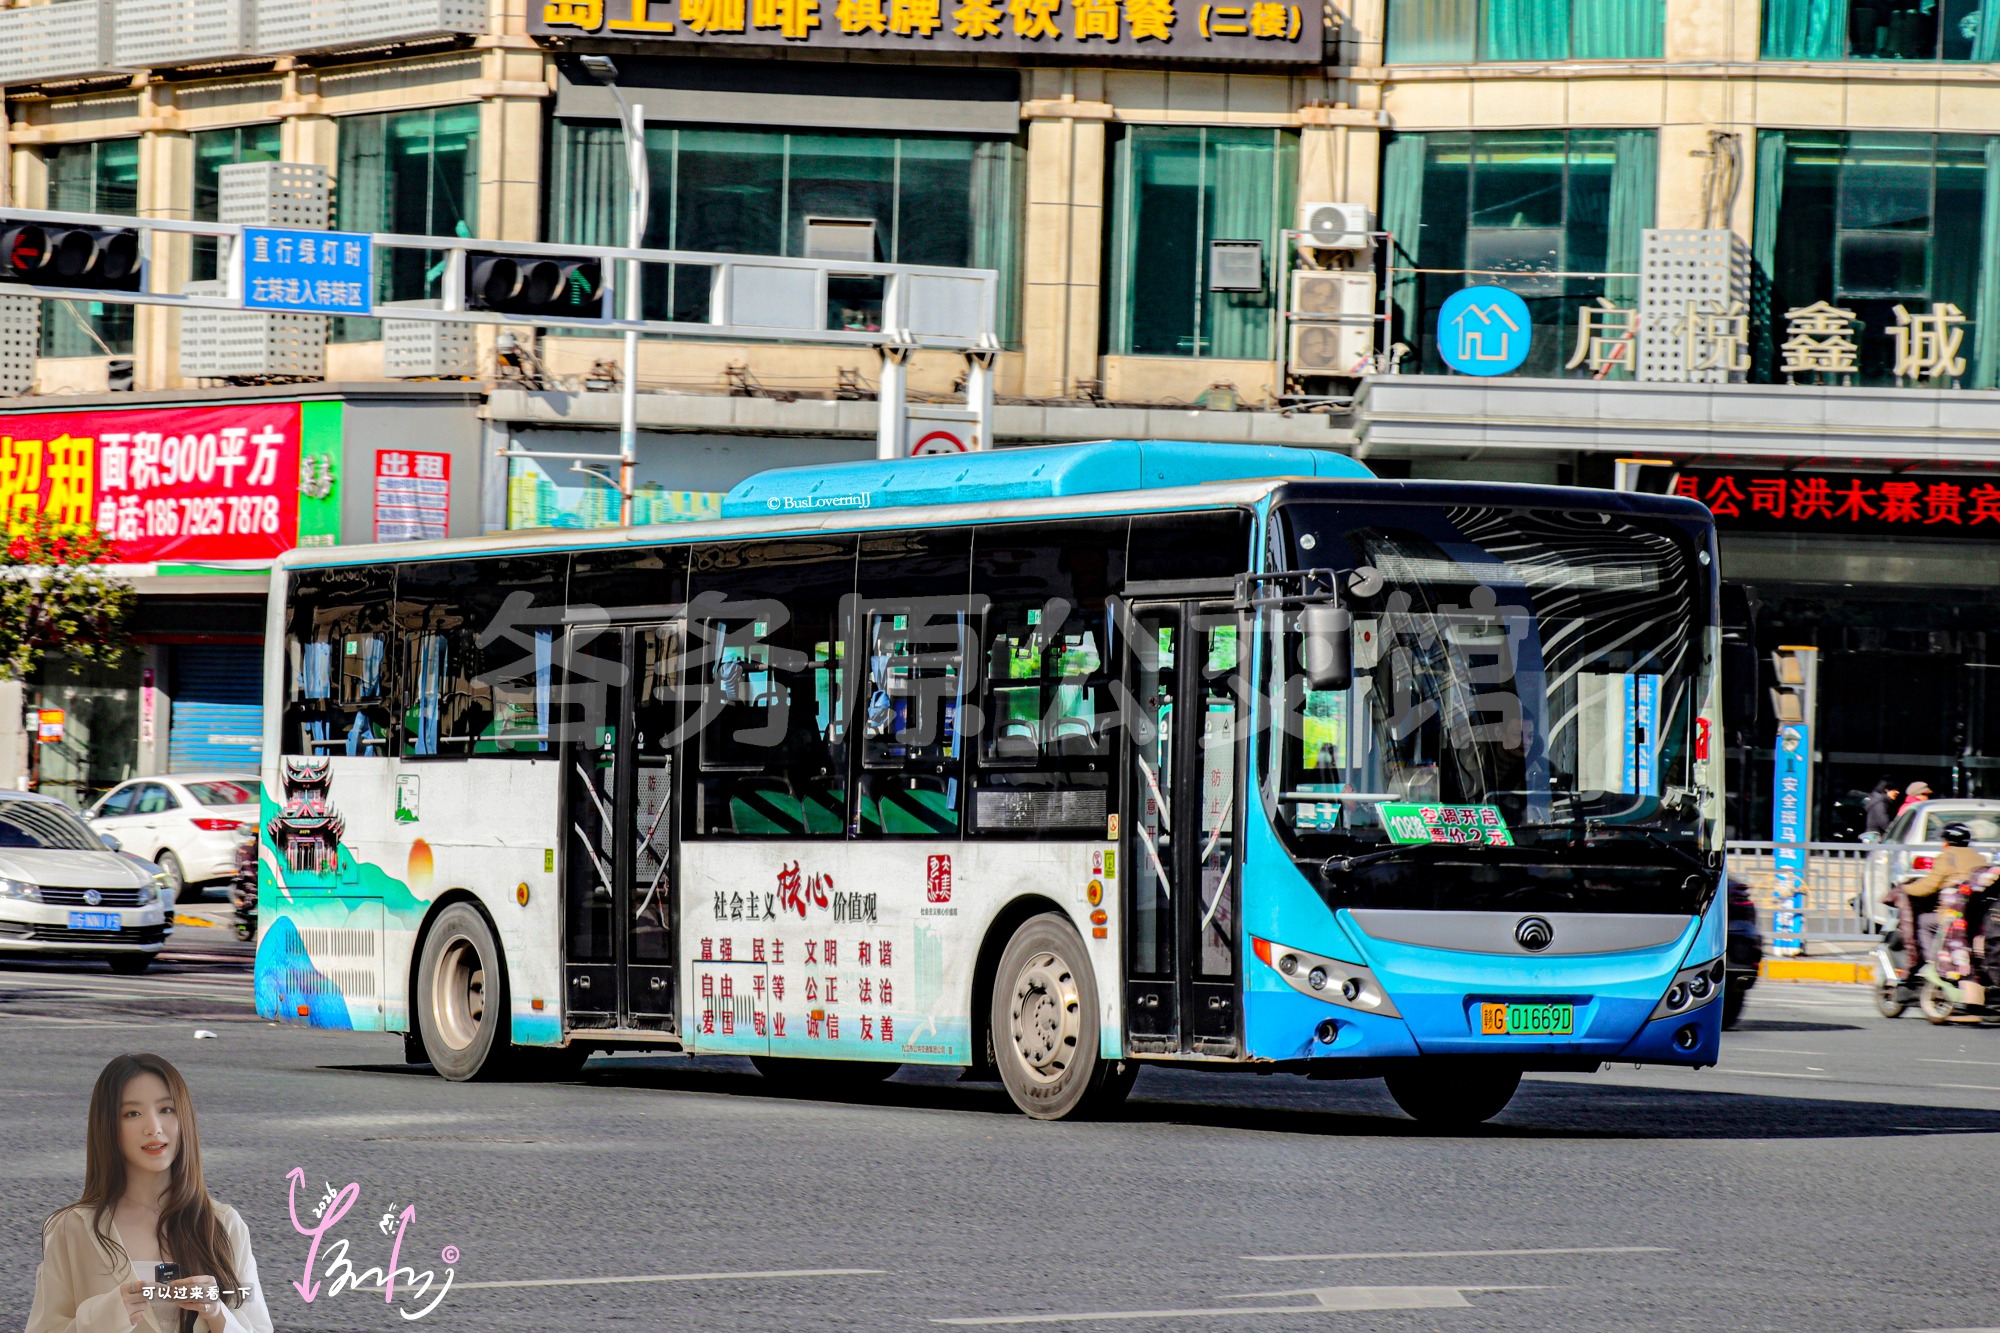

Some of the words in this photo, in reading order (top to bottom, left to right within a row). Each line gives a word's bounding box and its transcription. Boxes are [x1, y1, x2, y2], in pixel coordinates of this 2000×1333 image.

[252, 235, 362, 267] 直行绿灯时
[251, 276, 363, 306] 左转进入待转区
[1565, 296, 1968, 379] 启悦鑫诚
[99, 424, 285, 493] 面积900平方
[381, 452, 445, 478] 出租
[1419, 806, 1500, 826] 空调开启
[700, 936, 733, 962] 富强
[752, 937, 785, 965] 民主
[803, 938, 838, 967] 文明
[857, 939, 892, 968] 和谐
[701, 972, 733, 1000] 自由
[752, 973, 785, 1002] 平等
[804, 975, 839, 1004] 公正
[858, 976, 893, 1005] 法治
[702, 1008, 734, 1036] 爱国
[753, 1010, 787, 1038] 敬业
[806, 1012, 840, 1040] 诚信
[859, 1013, 895, 1043] 友善
[1511, 1008, 1571, 1030] 01669D
